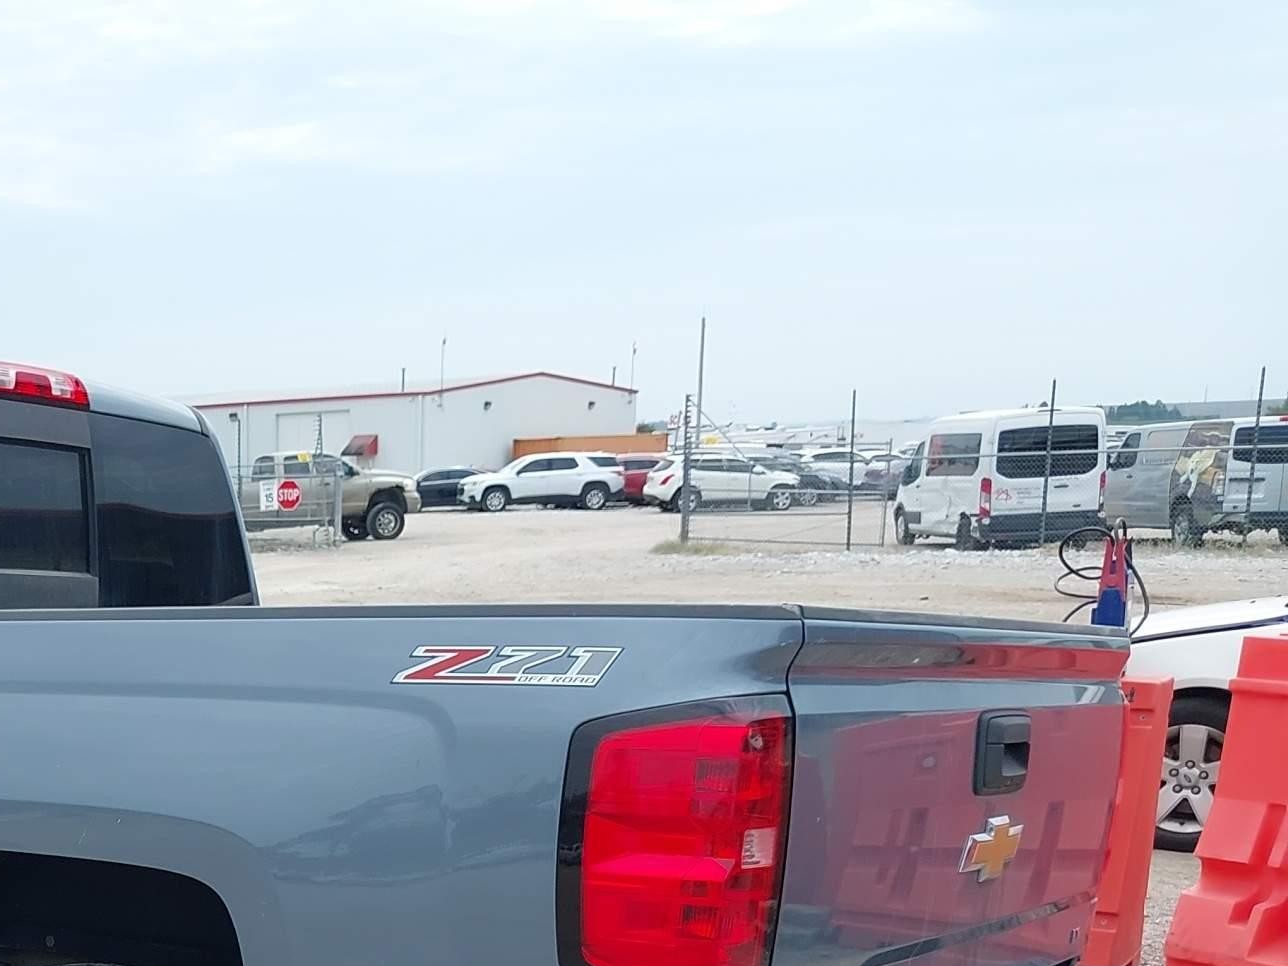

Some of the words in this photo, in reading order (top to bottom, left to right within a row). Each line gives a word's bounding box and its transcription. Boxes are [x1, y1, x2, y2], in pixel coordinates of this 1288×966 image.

[264, 492, 274, 504] 15
[278, 489, 300, 502] STOP
[391, 645, 624, 688] Z71
[517, 675, 550, 683] OFF
[551, 676, 597, 684] ROAD
